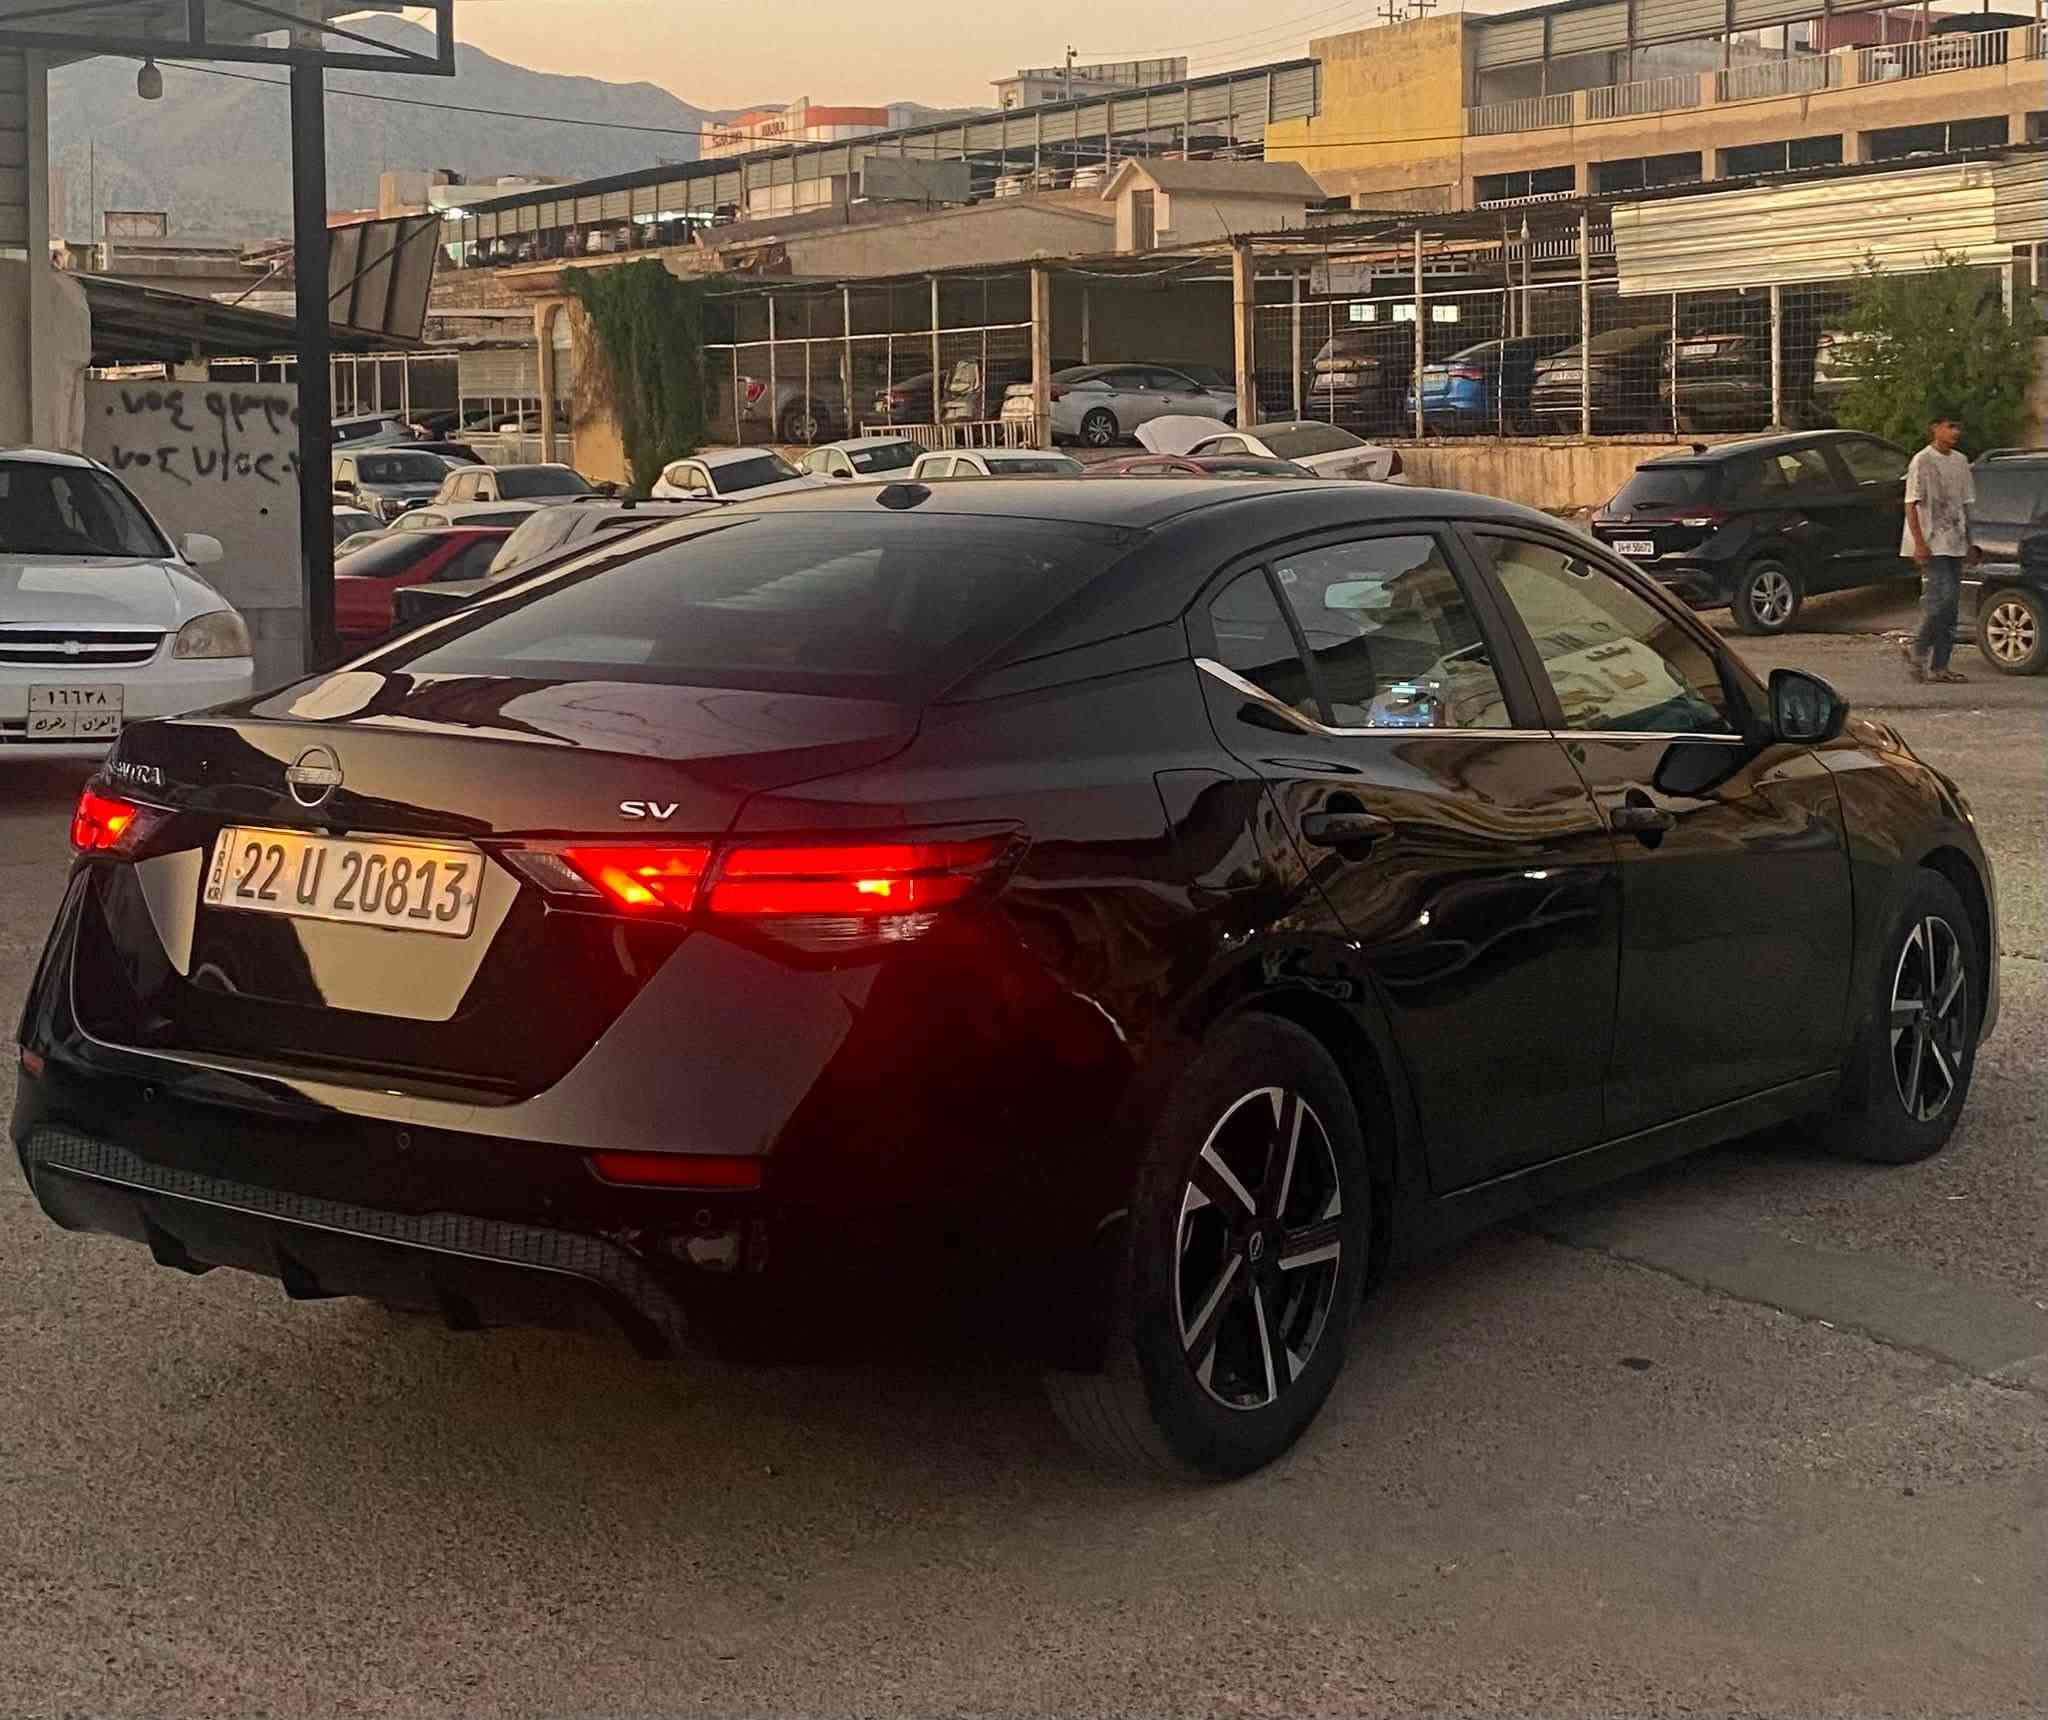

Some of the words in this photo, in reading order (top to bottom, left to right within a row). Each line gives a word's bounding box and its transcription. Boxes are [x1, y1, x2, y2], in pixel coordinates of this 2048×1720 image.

[620, 801, 680, 818] SV
[236, 842, 286, 900] 22
[296, 846, 329, 905] U
[333, 852, 469, 921] 20813
